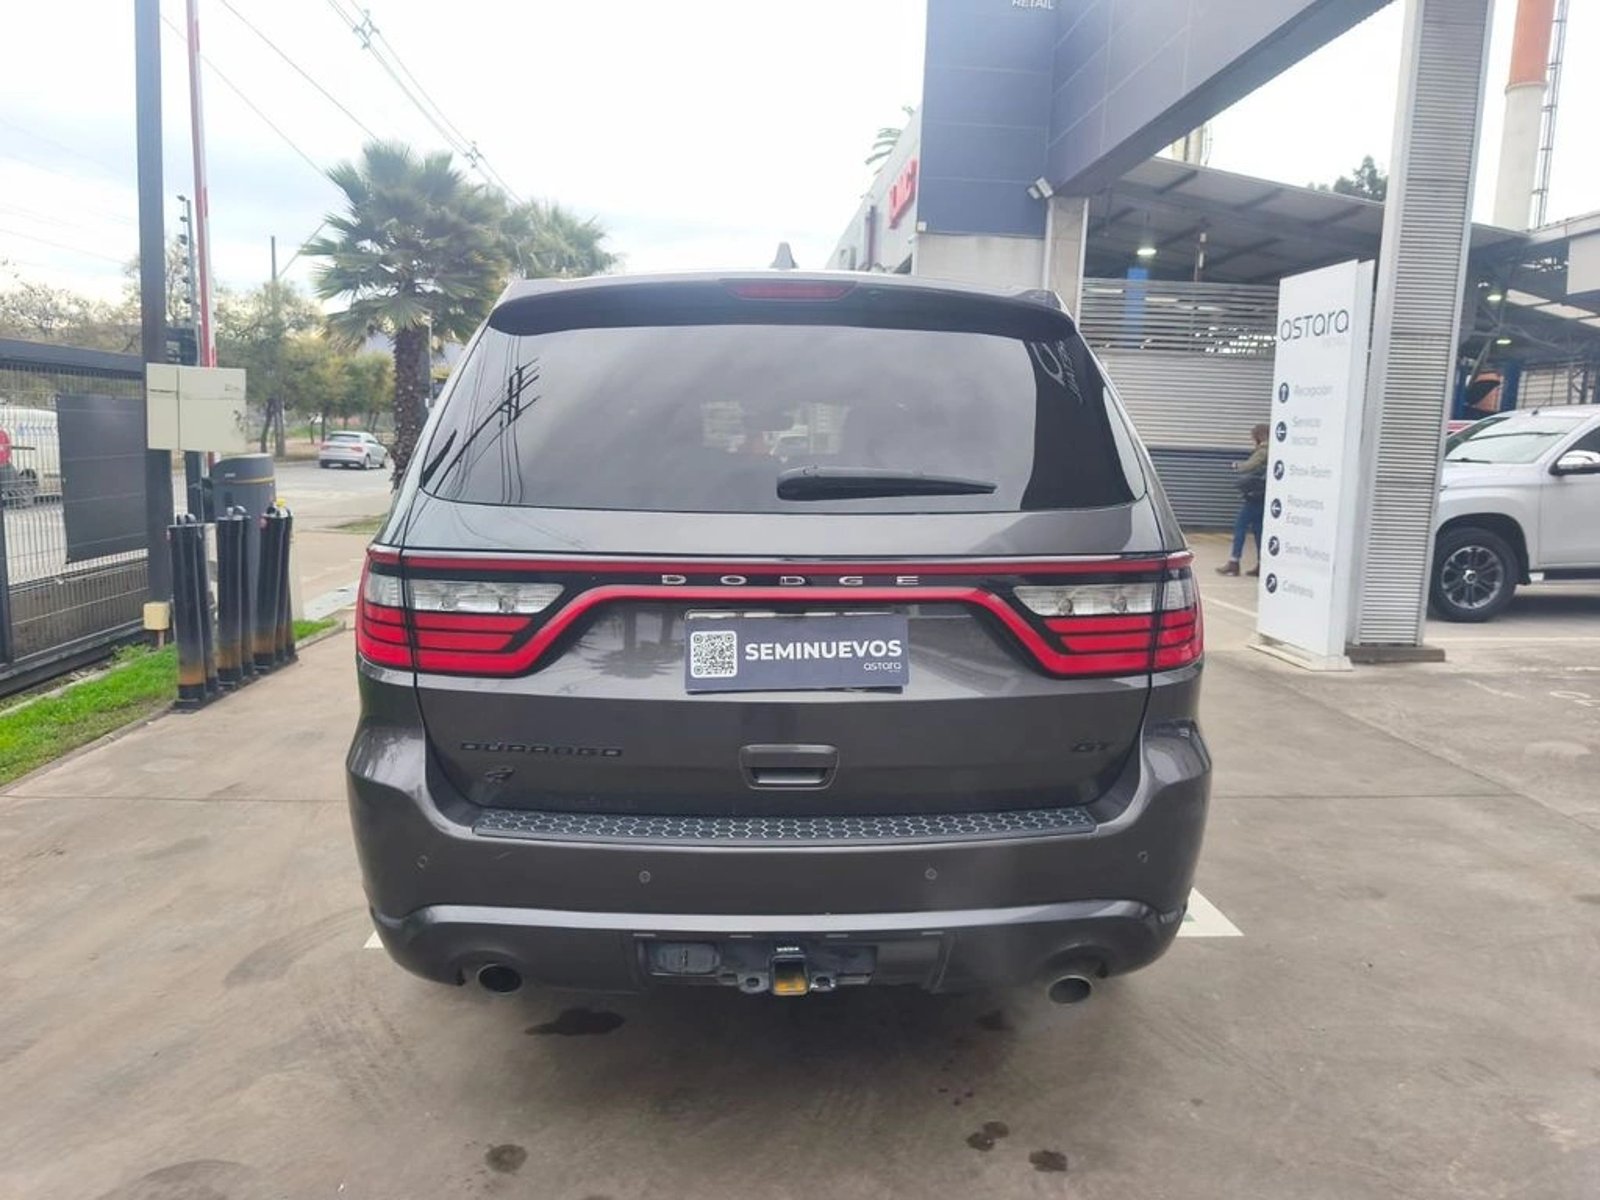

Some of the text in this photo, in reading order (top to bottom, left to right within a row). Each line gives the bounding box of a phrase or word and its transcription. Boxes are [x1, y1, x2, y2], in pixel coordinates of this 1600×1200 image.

[1280, 309, 1349, 341] astara
[661, 574, 919, 586] DODGE
[744, 639, 902, 661] SEMINUEVOS
[863, 662, 902, 672] astara
